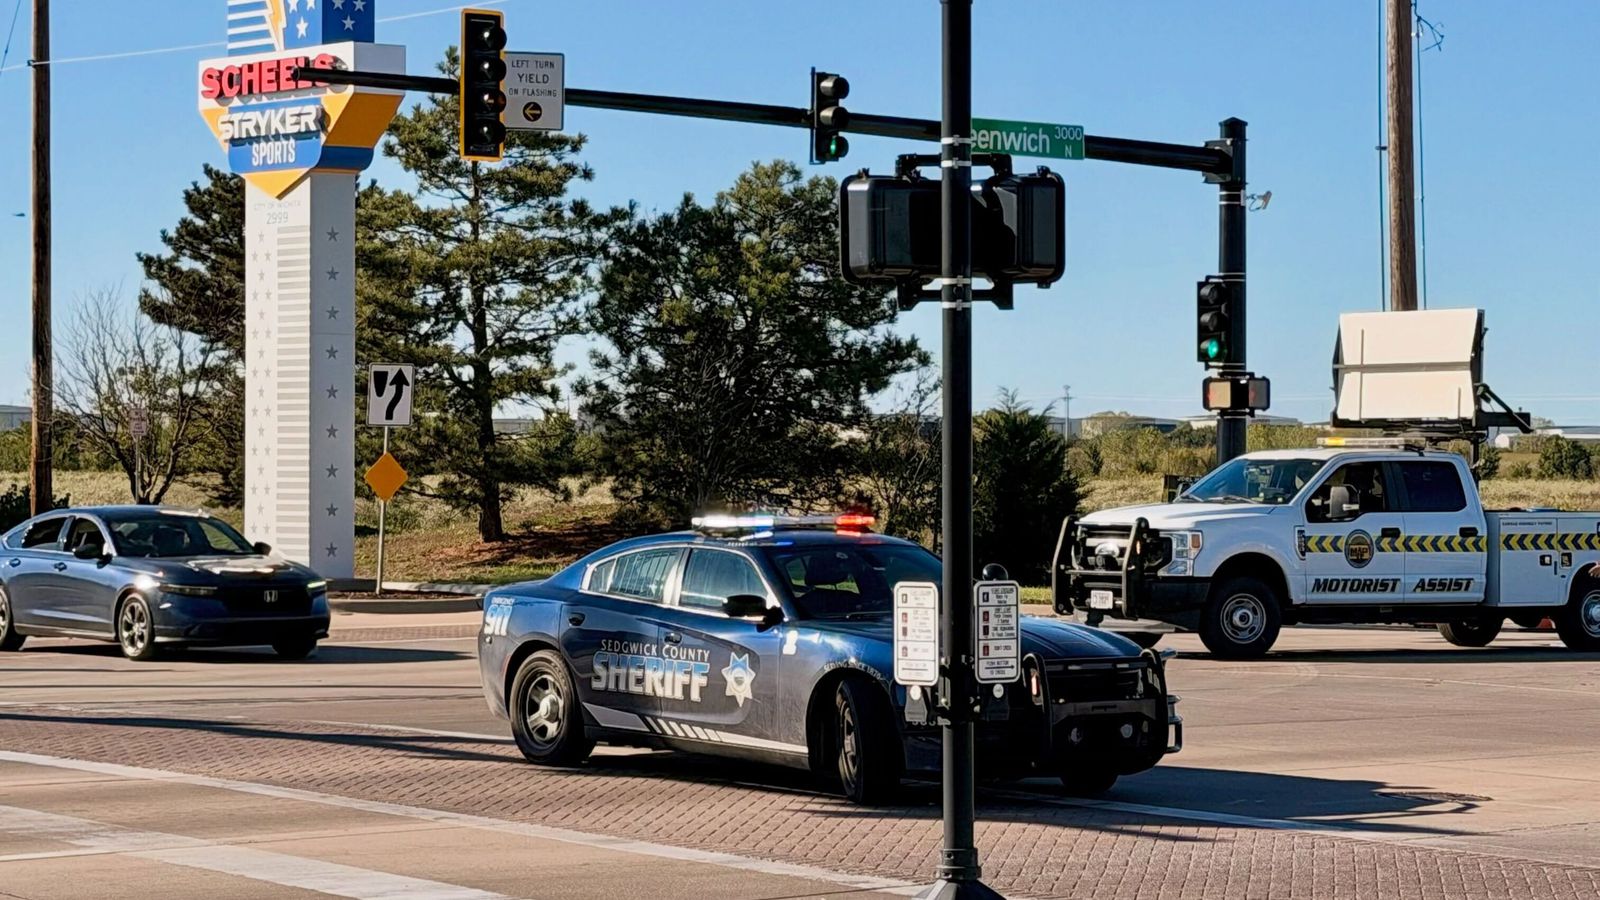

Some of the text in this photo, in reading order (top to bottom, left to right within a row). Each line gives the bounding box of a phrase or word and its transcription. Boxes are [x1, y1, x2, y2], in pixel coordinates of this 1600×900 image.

[512, 60, 555, 69] LEFT TURN
[201, 53, 335, 99] SCHEELS
[517, 73, 549, 84] YIELD
[508, 88, 557, 97] ON FLASHING
[218, 104, 317, 140] STRYKER
[1054, 126, 1083, 140] 3000
[252, 139, 296, 166] SPORTS
[1064, 144, 1073, 158] N
[266, 211, 289, 225] 2999
[1311, 578, 1474, 593] MOTORIST ASSIST
[484, 604, 513, 637] 911
[601, 639, 711, 662] SEDGWICK COUNTY
[591, 650, 711, 703] SHERIFF
